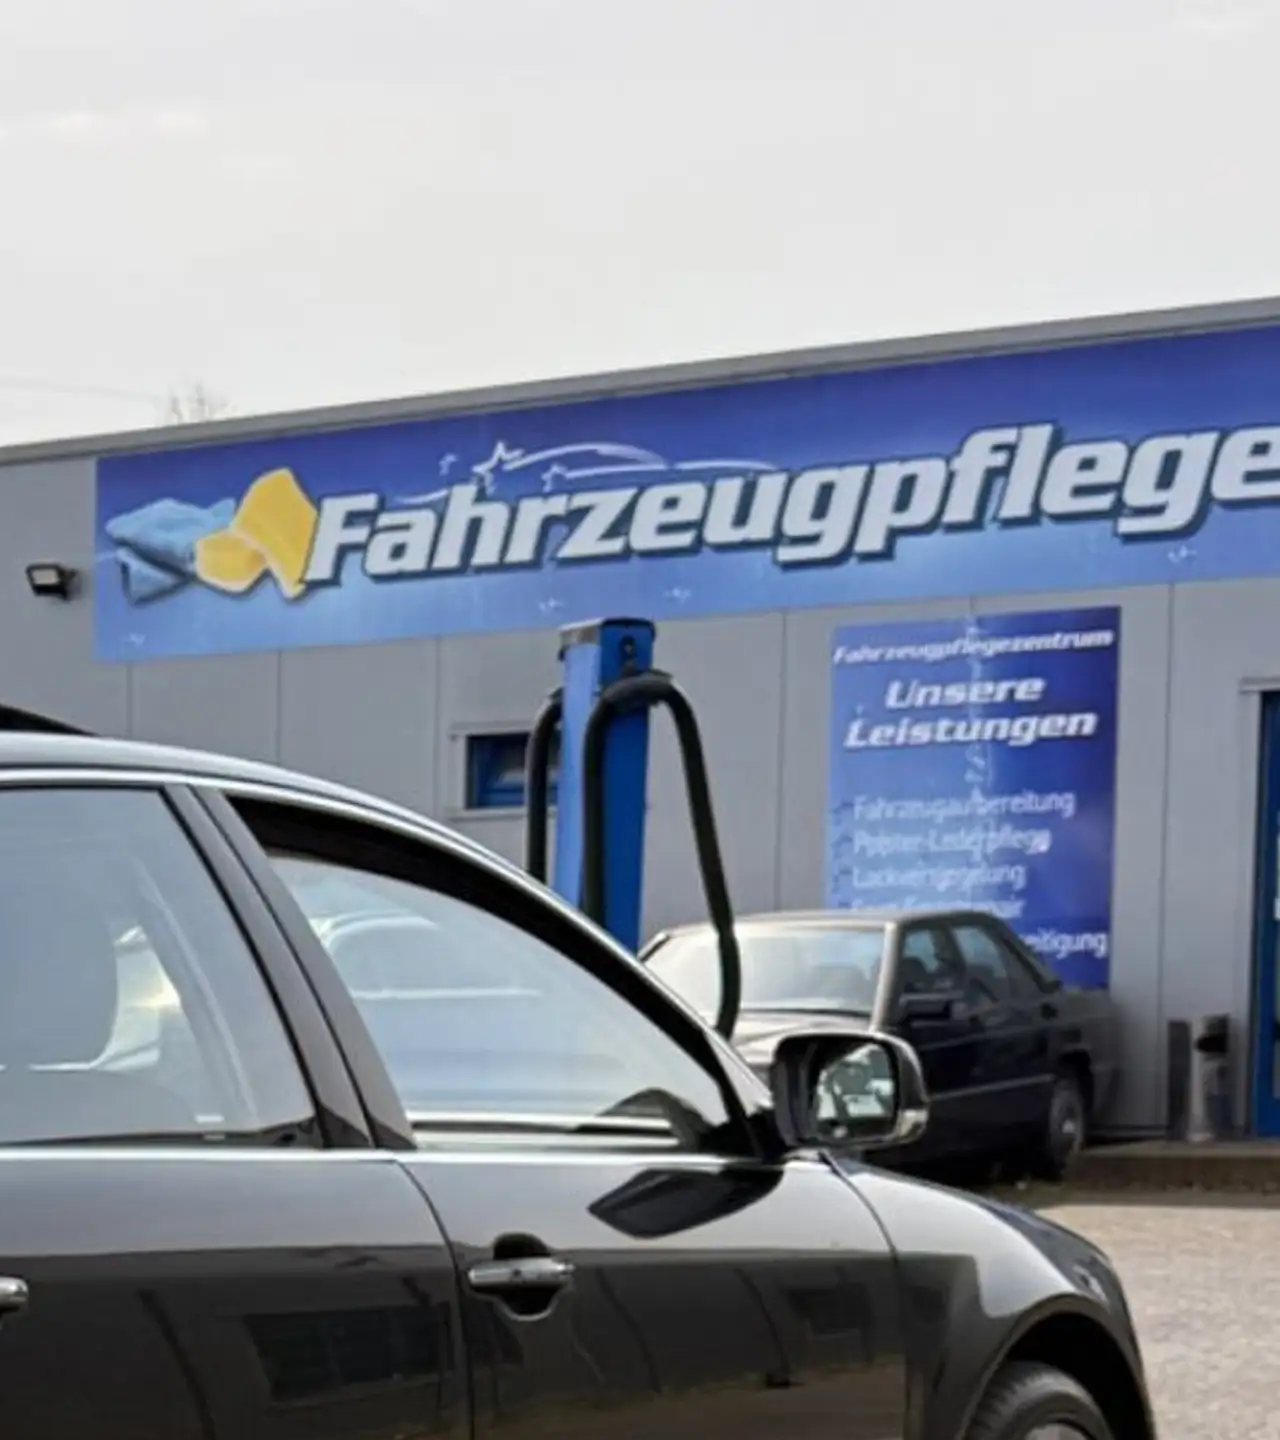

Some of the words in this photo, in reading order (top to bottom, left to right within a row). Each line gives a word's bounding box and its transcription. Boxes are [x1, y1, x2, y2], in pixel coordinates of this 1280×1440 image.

[305, 422, 1280, 582] Fahrzeugpflege
[833, 628, 1115, 665] Fahrzeugpflegezentrum
[884, 676, 1047, 710] Unsere
[842, 711, 1099, 749] Leistungen
